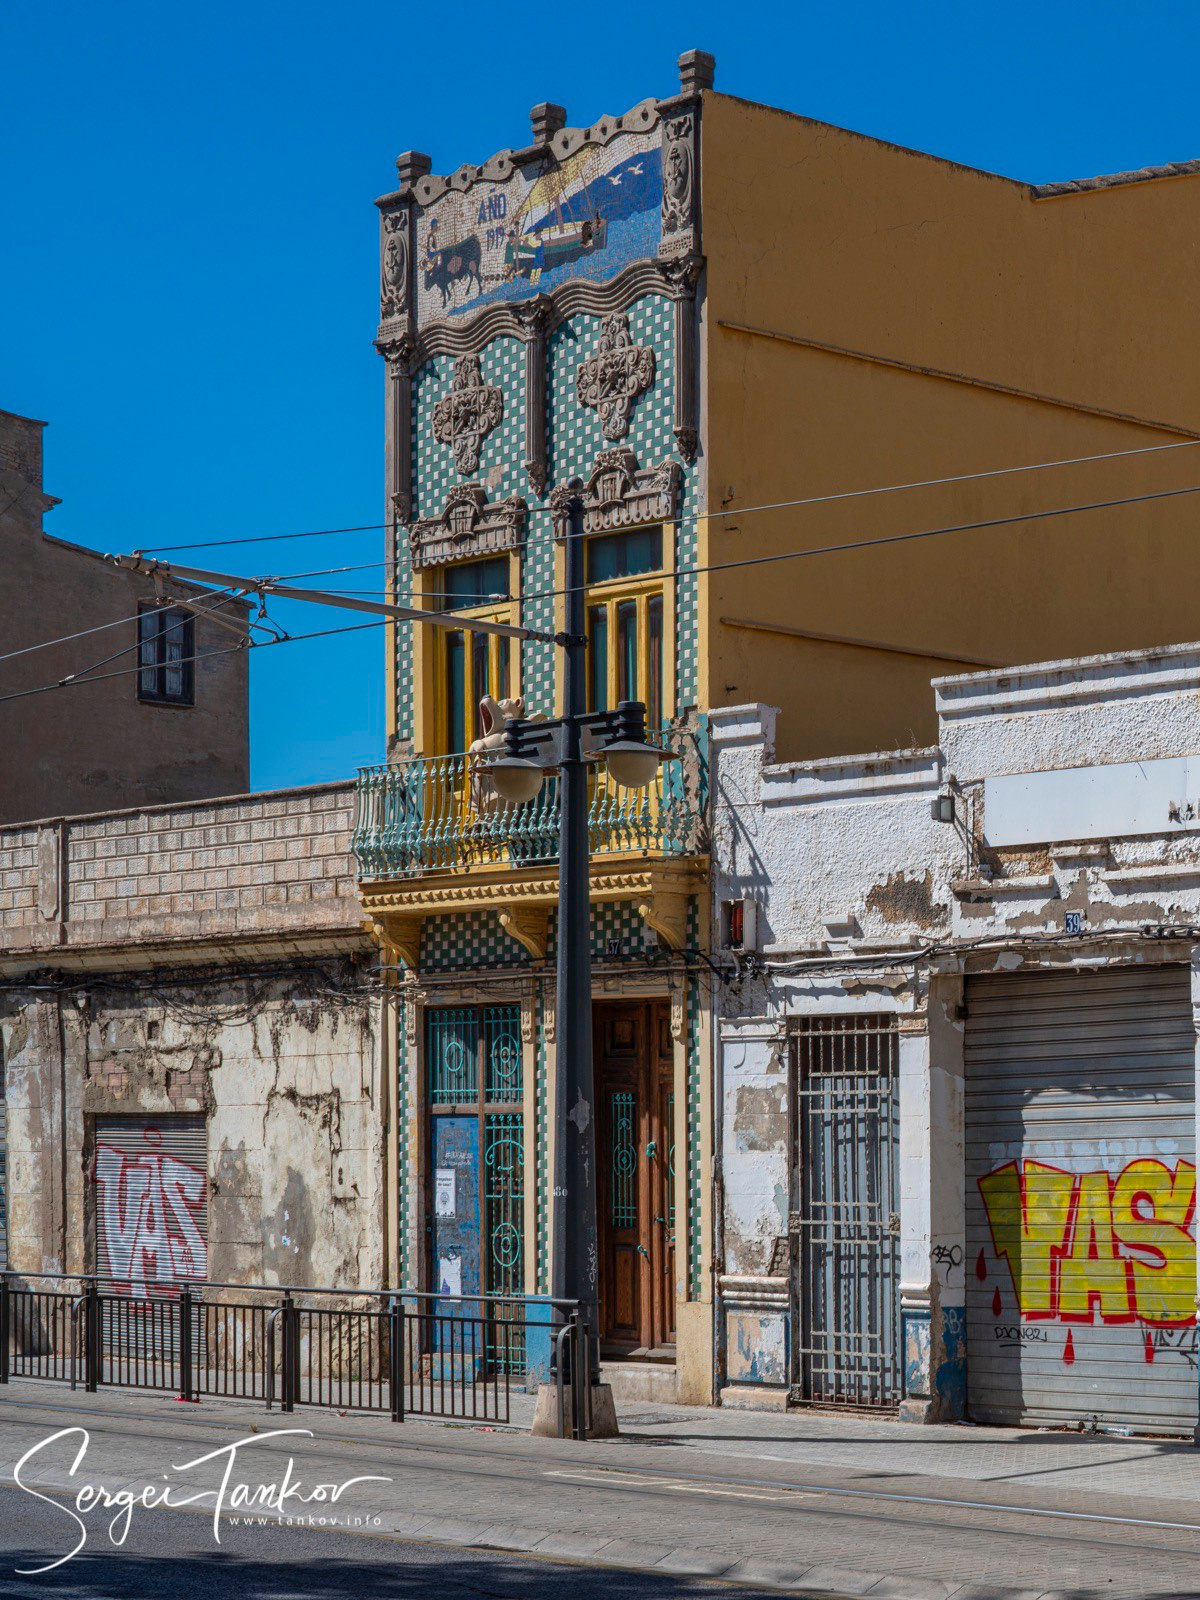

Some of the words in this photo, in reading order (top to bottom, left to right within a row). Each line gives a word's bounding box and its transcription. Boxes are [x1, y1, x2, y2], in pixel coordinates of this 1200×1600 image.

[478, 188, 507, 224] AÑO
[486, 226, 505, 251] 1919
[1066, 914, 1080, 933] 39
[553, 1185, 568, 1197] 80
